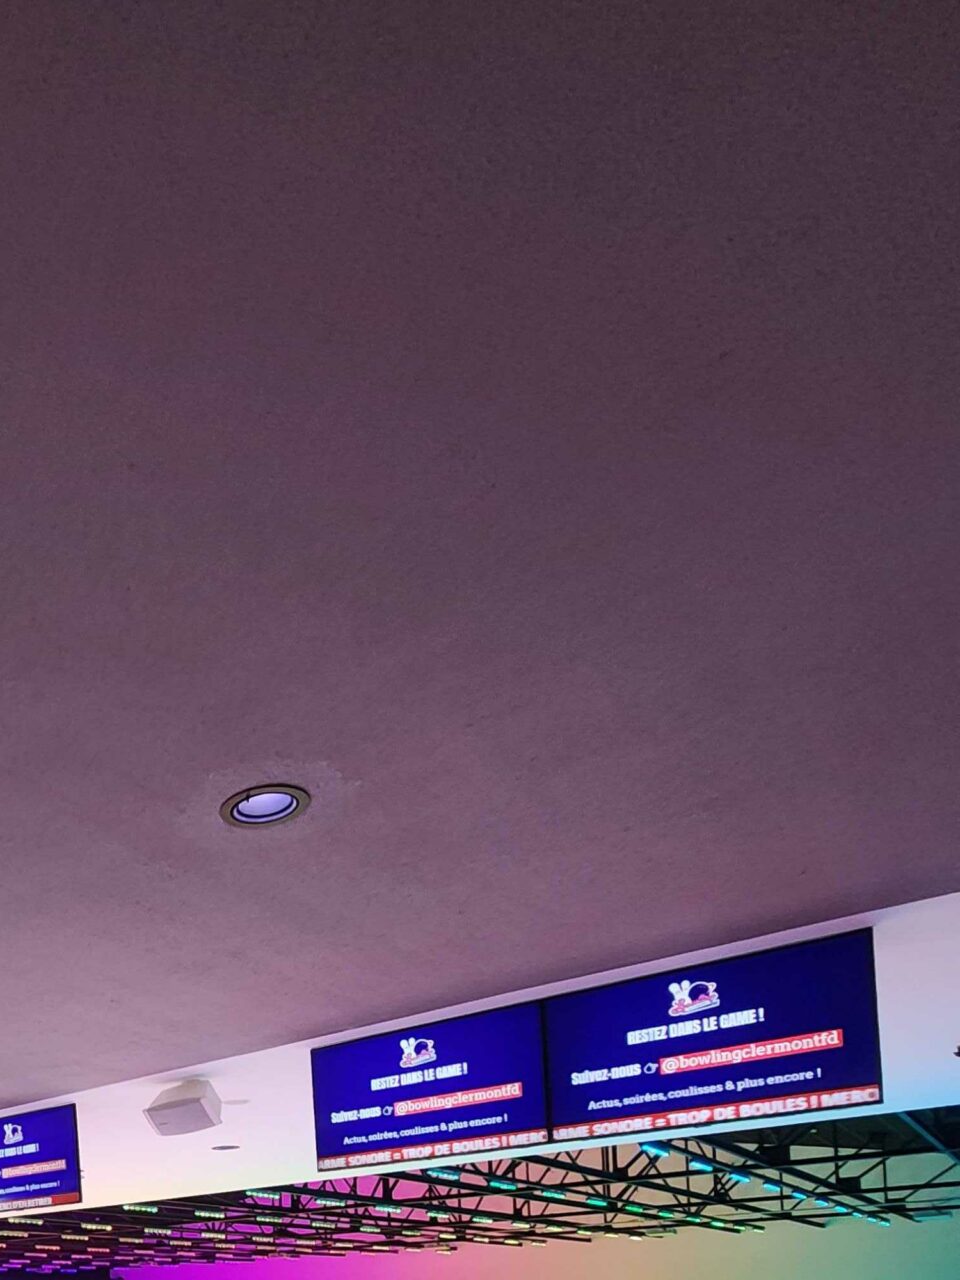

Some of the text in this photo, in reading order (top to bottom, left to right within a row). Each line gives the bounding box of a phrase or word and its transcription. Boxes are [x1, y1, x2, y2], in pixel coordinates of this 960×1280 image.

[626, 1007, 765, 1045] RESTEZ DANS LE GAME !
[423, 1068, 435, 1081] LE
[463, 1062, 468, 1075] !
[571, 1030, 839, 1085] Suivez-nous @bowlingclermontfd
[587, 1099, 622, 1110] Actus,
[667, 1084, 723, 1099] coulisses
[725, 1080, 735, 1091] &
[736, 1077, 765, 1091] plus
[766, 1070, 814, 1085] encore
[448, 1121, 468, 1132] plus
[469, 1116, 502, 1127] encore
[592, 1117, 653, 1136] SONORE
[667, 1109, 711, 1126] TROP
[713, 1106, 737, 1121] DE
[739, 1097, 808, 1118] BOULES
[809, 1095, 818, 1108] !
[401, 1146, 433, 1159] TROP
[434, 1143, 451, 1156] DE
[452, 1137, 500, 1154] BOULES
